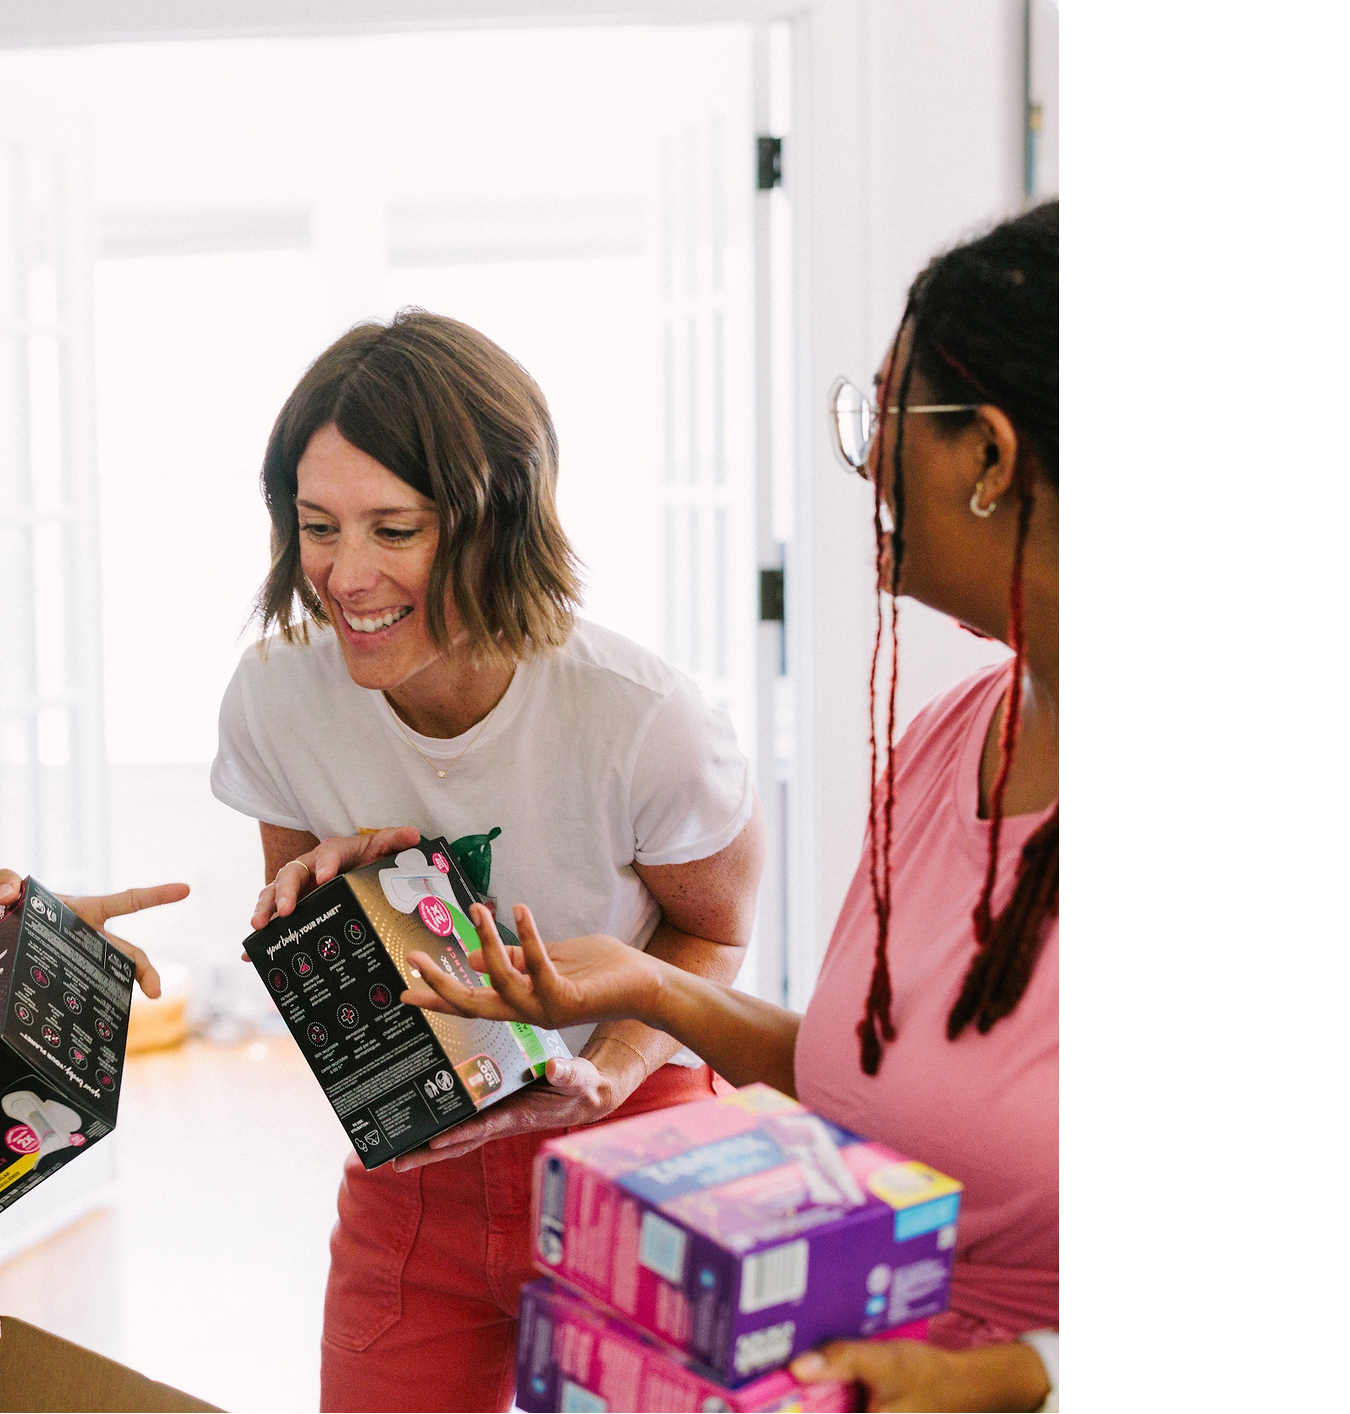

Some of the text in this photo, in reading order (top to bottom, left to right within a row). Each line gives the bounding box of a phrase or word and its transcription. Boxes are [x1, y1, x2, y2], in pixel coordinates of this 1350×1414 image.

[265, 939, 286, 961] your
[298, 919, 317, 936] YOUR
[440, 956, 458, 981] tex
[46, 1051, 64, 1070] YOUR
